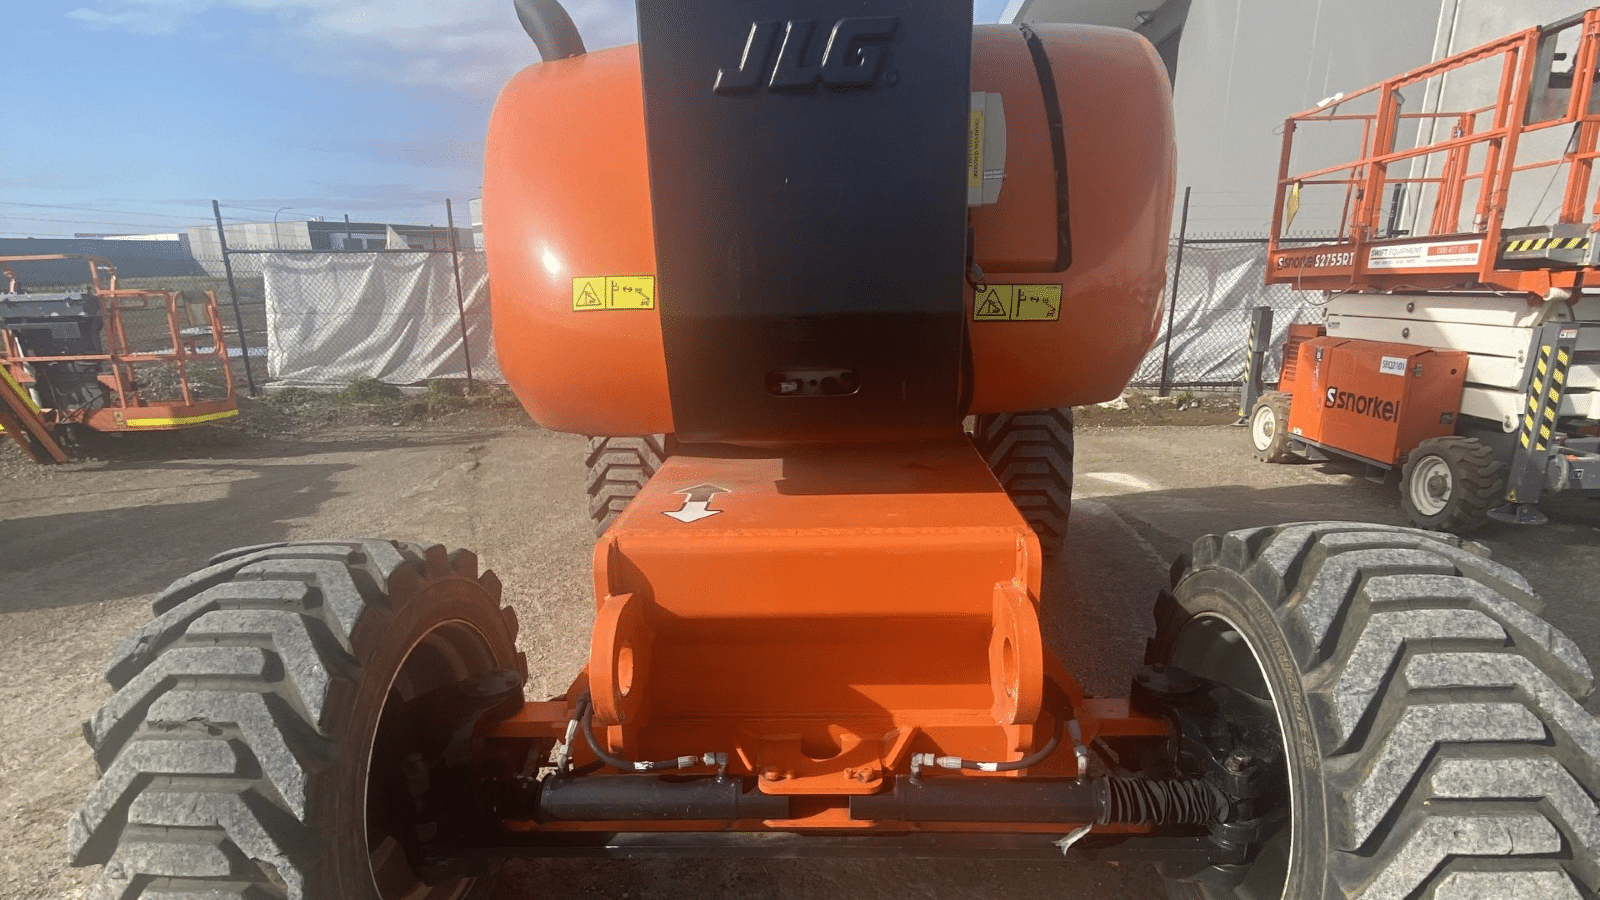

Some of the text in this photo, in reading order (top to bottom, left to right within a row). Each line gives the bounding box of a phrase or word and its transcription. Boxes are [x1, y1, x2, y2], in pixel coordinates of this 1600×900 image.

[713, 18, 898, 97] JLG
[1314, 252, 1355, 267] S2755RT
[1371, 248, 1388, 257] SWIFT
[1337, 390, 1400, 423] snorkel
